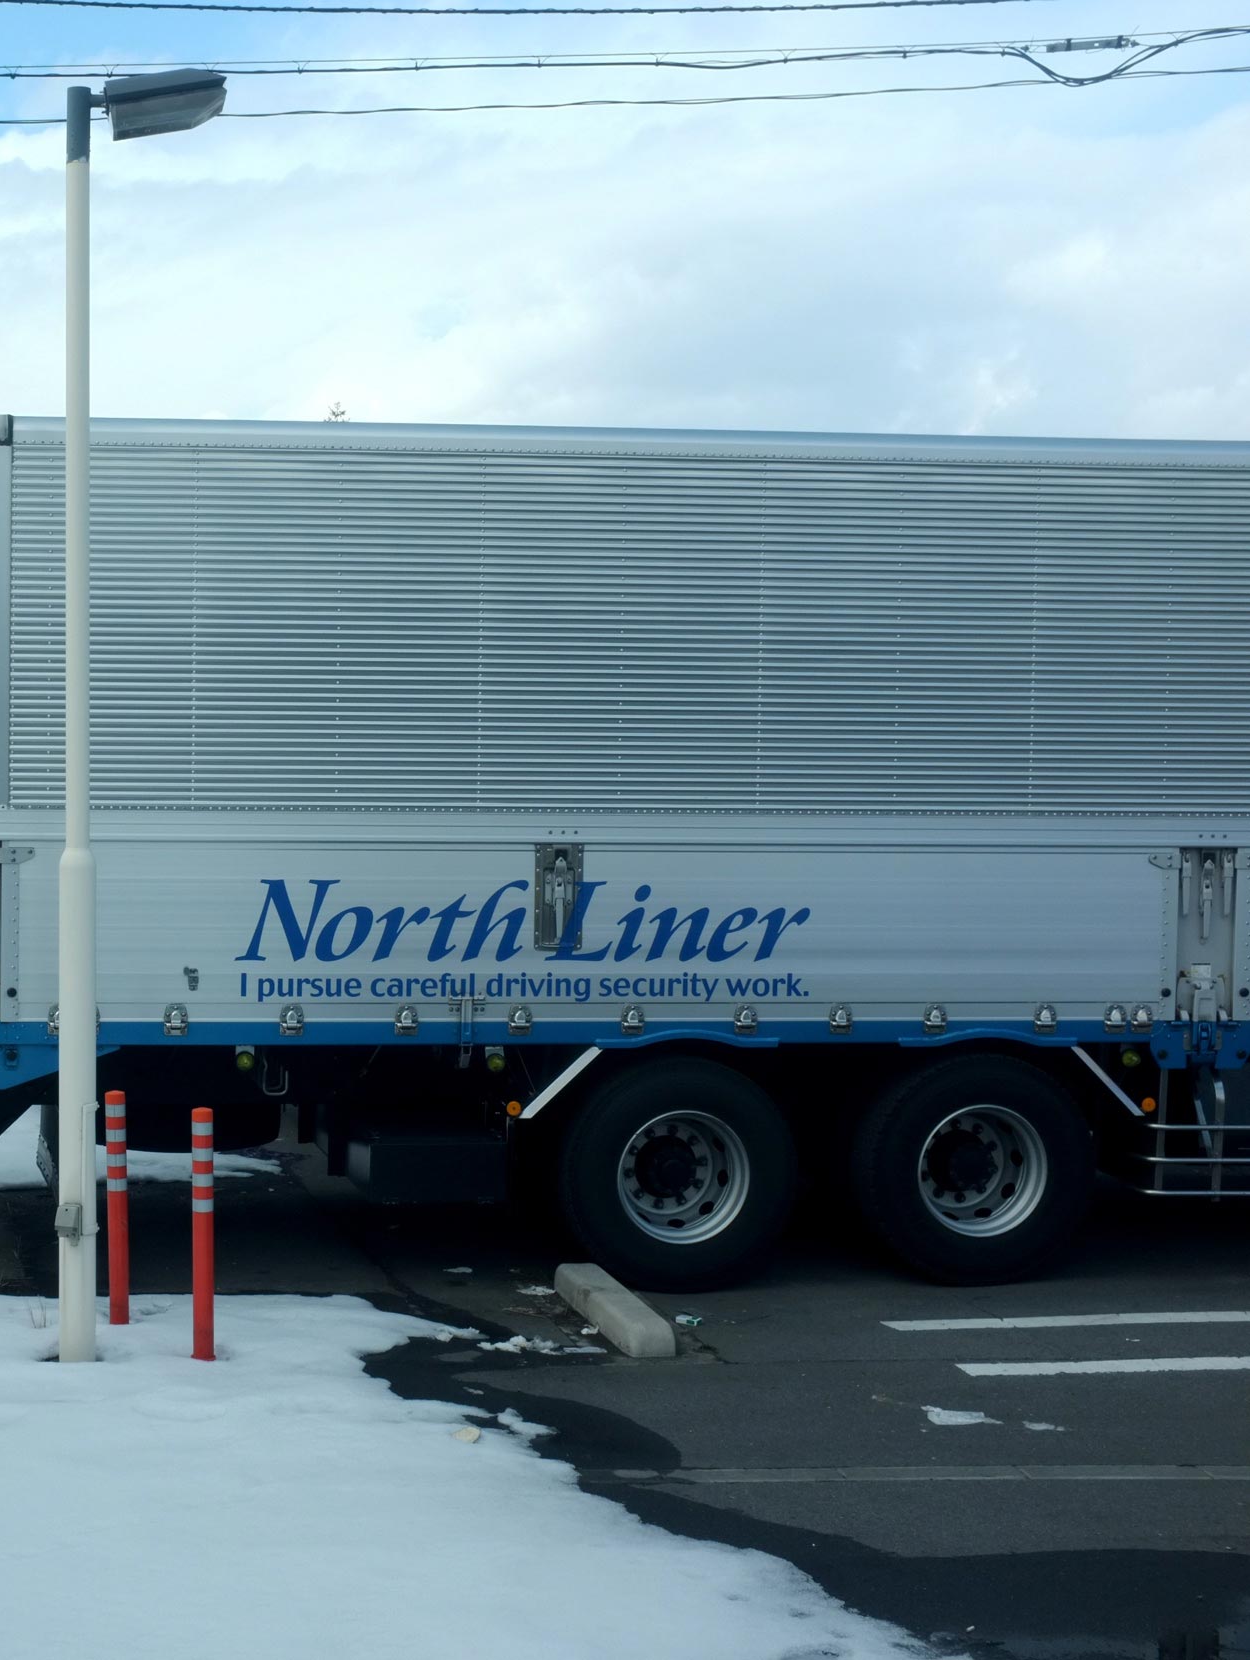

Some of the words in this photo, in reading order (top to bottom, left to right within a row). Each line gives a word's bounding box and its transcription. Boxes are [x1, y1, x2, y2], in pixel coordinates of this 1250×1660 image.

[234, 878, 529, 963] North
[544, 880, 811, 963] Liner
[240, 972, 247, 998] I
[257, 978, 362, 1003] pursue
[370, 972, 476, 998] careful
[486, 972, 592, 1003] driving
[599, 973, 720, 1003] security
[726, 972, 810, 998] work.
